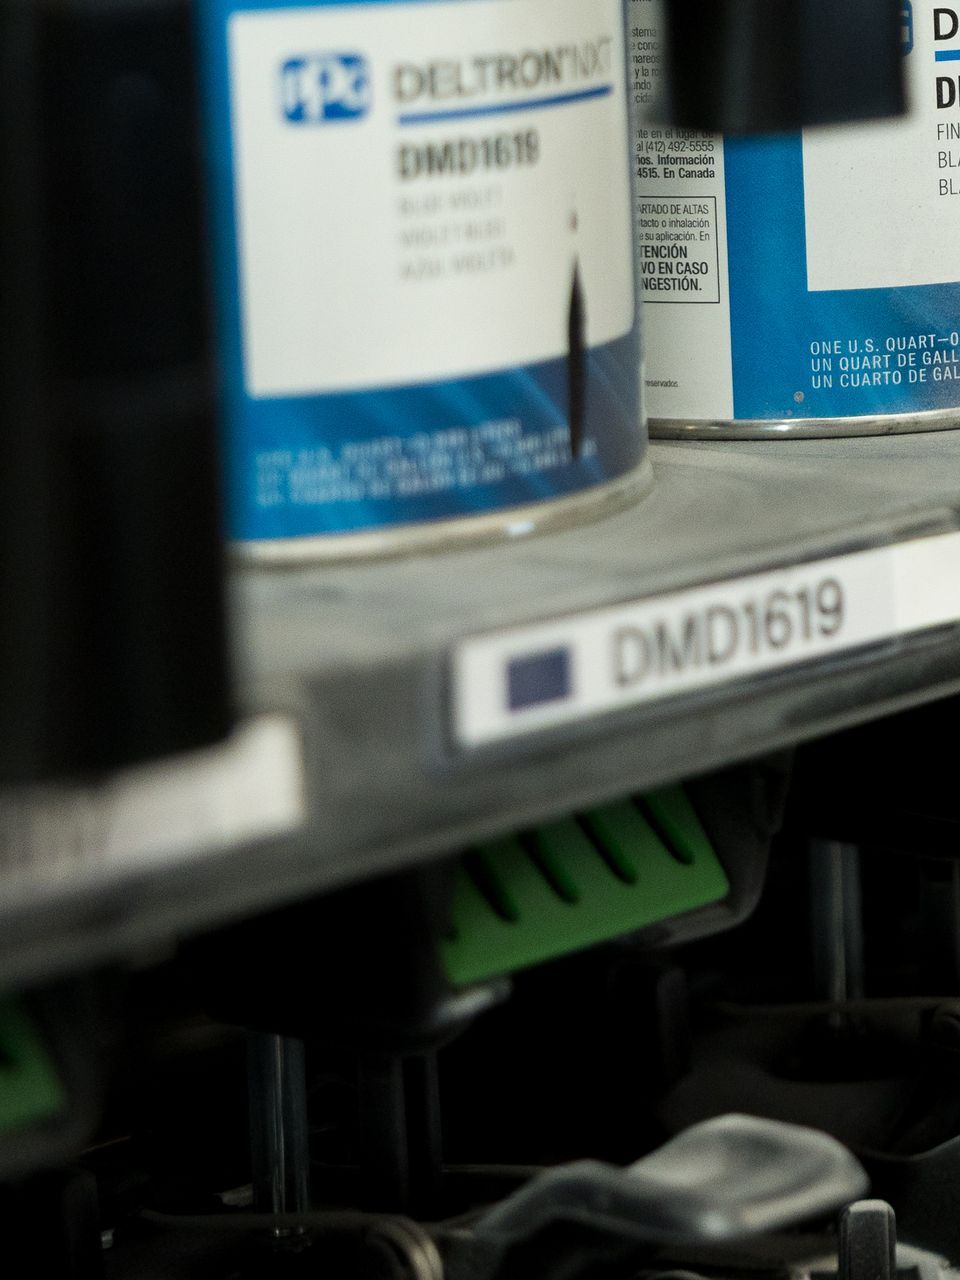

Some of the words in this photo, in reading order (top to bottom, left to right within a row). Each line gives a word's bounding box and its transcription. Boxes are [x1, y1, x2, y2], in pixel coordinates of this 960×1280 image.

[646, 140, 666, 153] (412)
[668, 140, 715, 152] 492-5555
[657, 153, 715, 166] Información
[663, 167, 675, 179] En
[678, 167, 715, 179] Canada
[670, 203, 681, 215] DE
[683, 204, 709, 215] ALTAS
[669, 217, 710, 228] inhalación
[645, 232, 654, 241] su
[655, 230, 698, 243] aplicación.
[699, 231, 710, 241] En
[658, 261, 673, 275] EN
[676, 261, 709, 275] CASO
[810, 340, 842, 356] ONE
[848, 338, 880, 354] U.S.
[811, 357, 832, 373] UN
[839, 354, 891, 372] QUART
[898, 352, 917, 368] DE
[811, 374, 833, 389] UN
[840, 370, 902, 388] CUARTO
[908, 368, 927, 383] DE
[612, 575, 844, 688] DMD1619
